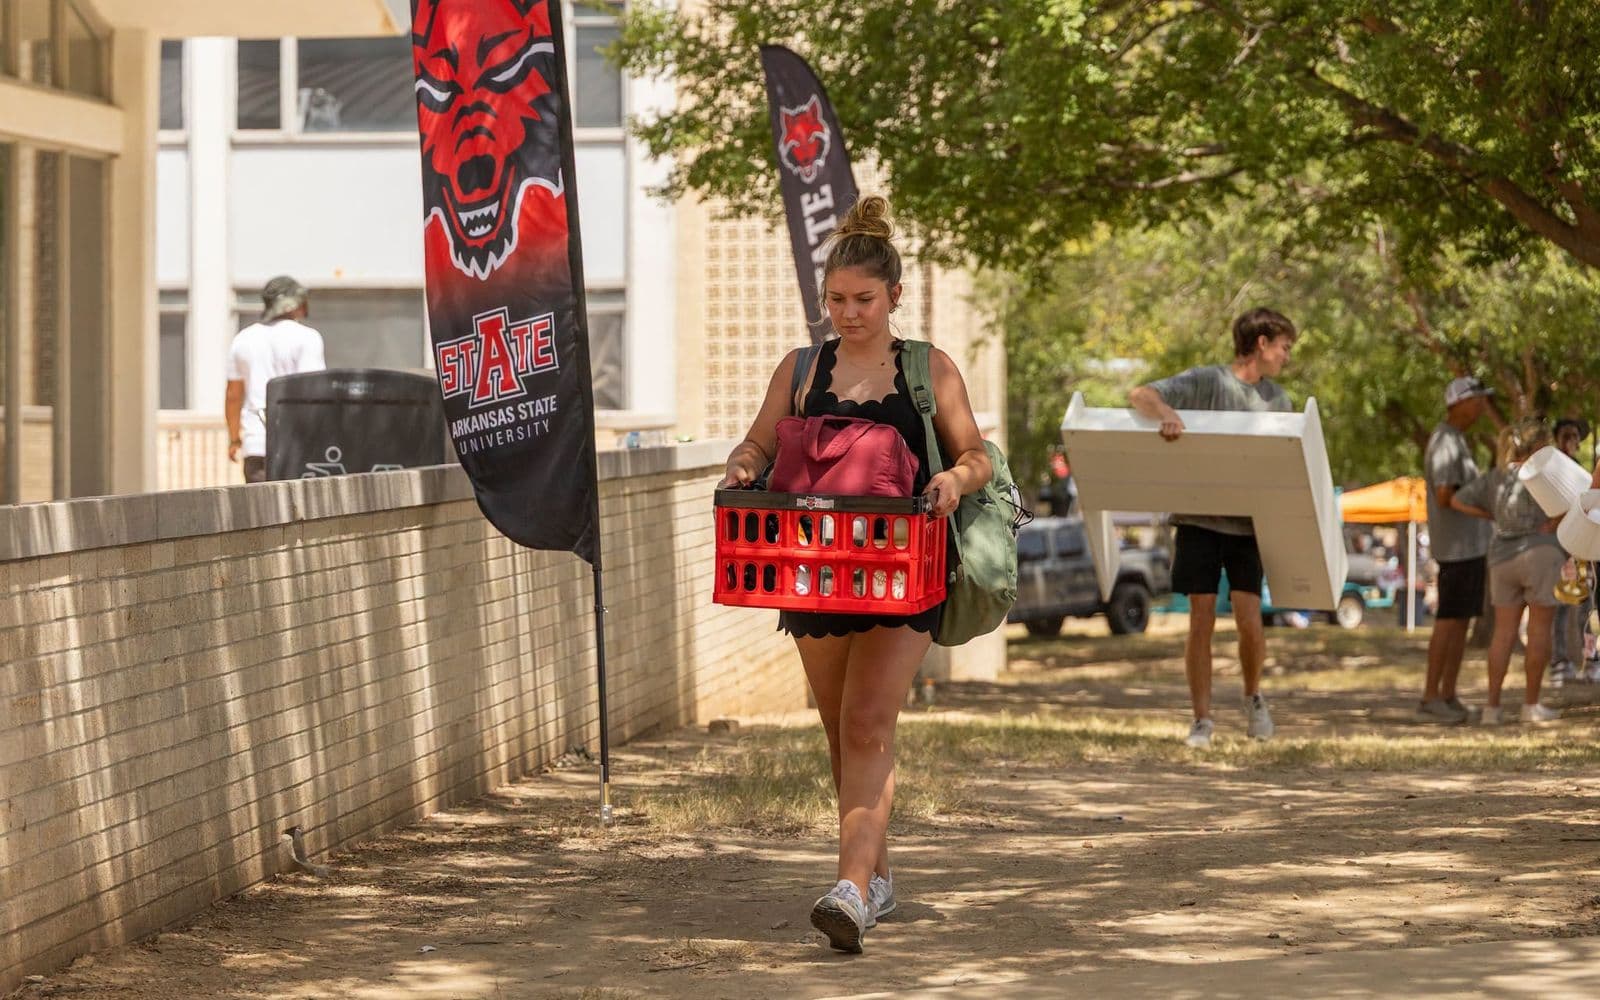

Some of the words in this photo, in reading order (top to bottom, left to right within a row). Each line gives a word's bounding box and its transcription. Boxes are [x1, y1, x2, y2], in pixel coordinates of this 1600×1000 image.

[436, 306, 559, 408] STATE
[451, 406, 516, 439] ARKANSAS
[517, 394, 558, 421] STATE
[459, 418, 550, 456] UNIVERSITY
